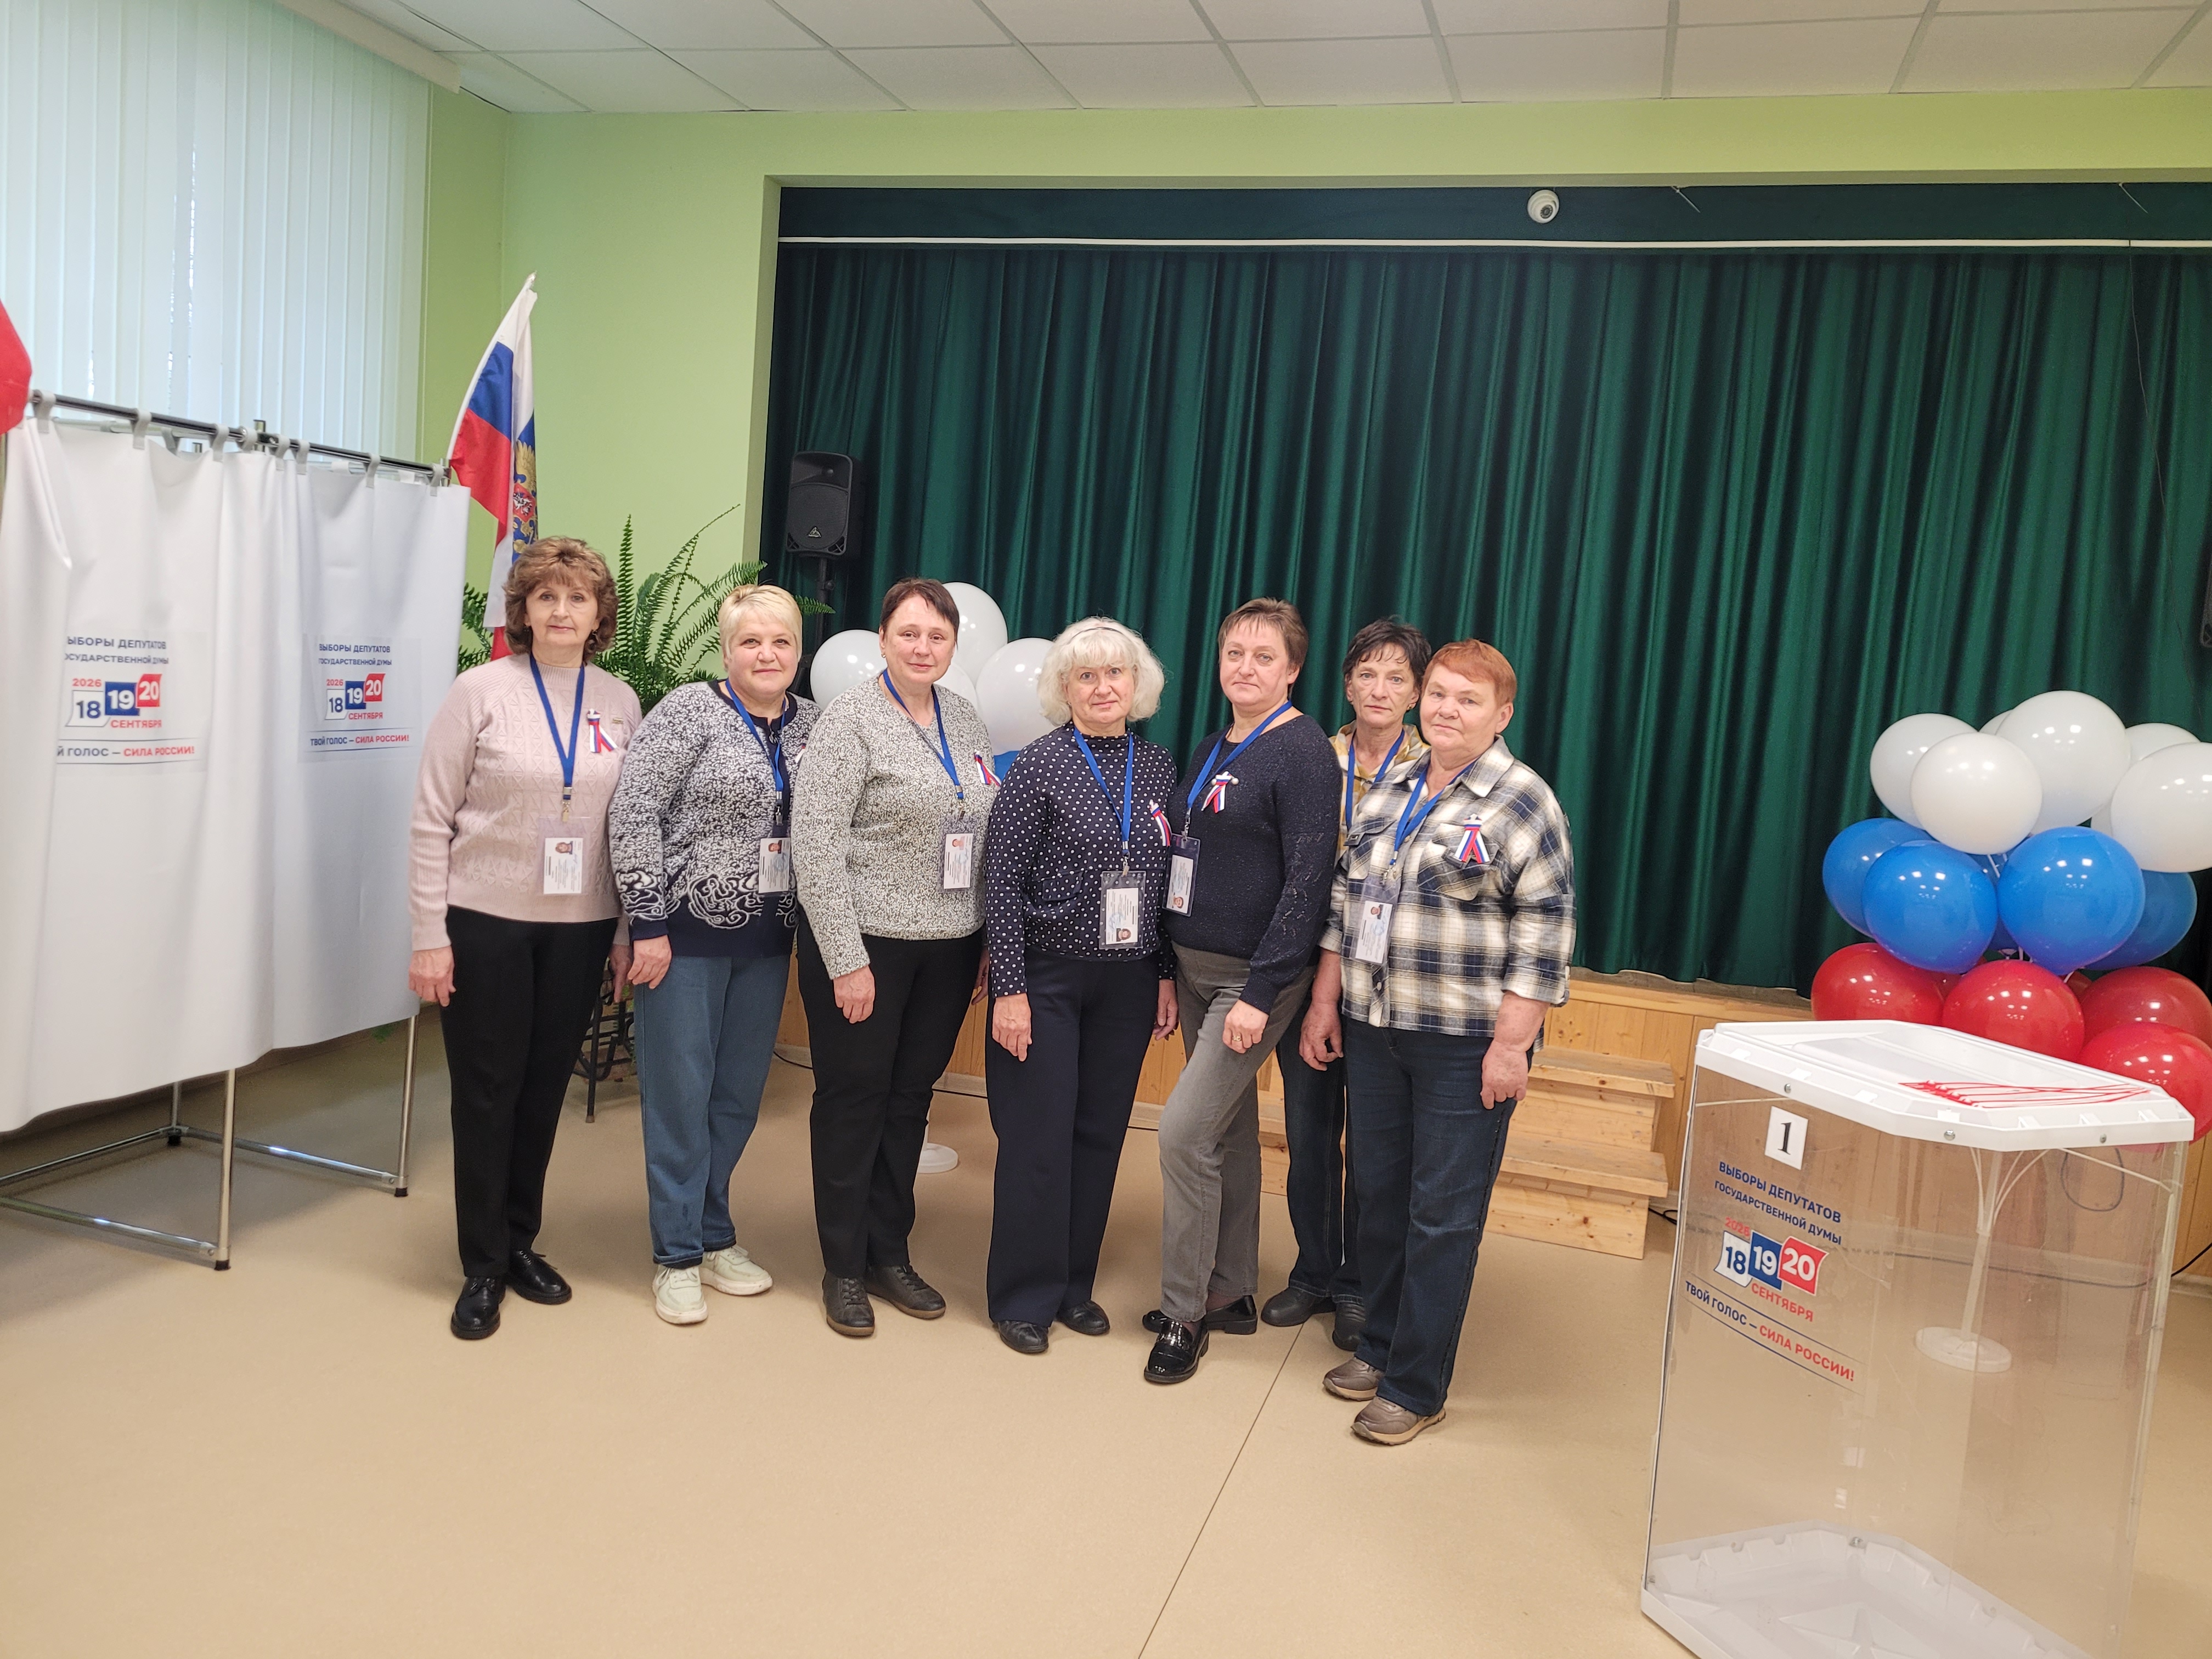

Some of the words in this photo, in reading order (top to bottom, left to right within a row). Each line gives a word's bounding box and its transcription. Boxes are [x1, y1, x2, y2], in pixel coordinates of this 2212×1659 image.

[67, 636, 114, 647] ЫБОРЫ
[118, 639, 167, 650] ДЕПУТАТОВ
[319, 644, 351, 652] ВЫБОРЫ
[72, 678, 102, 688] 2026
[329, 697, 343, 713] 18
[347, 687, 364, 704] 19
[366, 680, 382, 696] 20
[76, 700, 101, 719] 18
[108, 690, 135, 710] 19
[138, 681, 160, 700] 20
[348, 712, 383, 720] СЕНТЯБРЯ
[110, 719, 162, 729] СЕНТЯБРЯ
[67, 748, 109, 757] ГОЛОС
[123, 748, 153, 757] СИЛА
[155, 746, 195, 755] РОССИИ!
[311, 736, 326, 746] ТВОЙ
[327, 737, 348, 745] ГОЛОС
[1778, 1121, 1792, 1155] 1
[1718, 1161, 1767, 1192] ВЫБОРЫ
[1768, 1183, 1842, 1224] ДЕПУТАТОВ
[1714, 1180, 1807, 1229] ГОСУДАРСТВЕННОЙ
[1808, 1224, 1842, 1245] ДУМЫ
[1725, 1246, 1747, 1275] 18
[1753, 1245, 1778, 1276] 19
[1782, 1247, 1815, 1282] 20
[1751, 1283, 1814, 1323] СЕНТЯБРЯ
[1685, 1280, 1711, 1305] ТВОЙ
[1712, 1298, 1747, 1326] ГОЛОС
[1759, 1325, 1792, 1351] СИЛА
[1795, 1344, 1855, 1382] РОССИИ!
